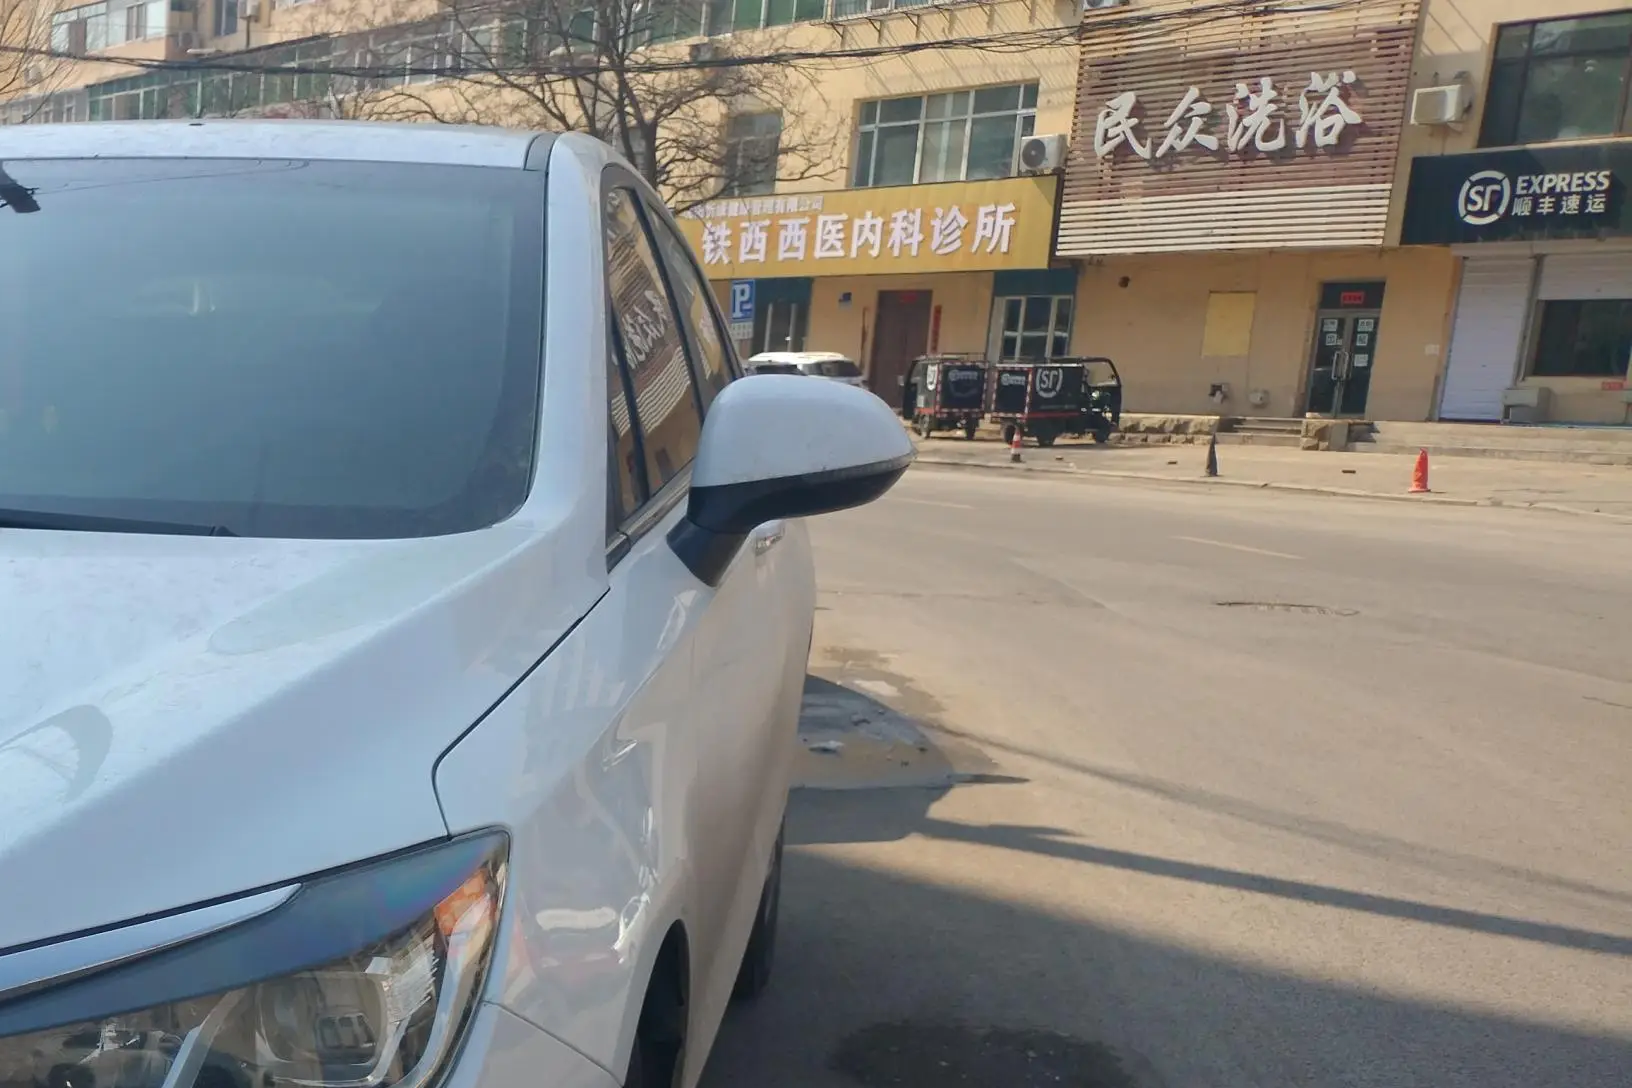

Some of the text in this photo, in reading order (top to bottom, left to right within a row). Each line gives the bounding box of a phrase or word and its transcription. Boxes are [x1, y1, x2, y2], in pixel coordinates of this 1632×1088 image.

[1094, 70, 1362, 159] 民众洗浴
[1515, 170, 1612, 195] EXPRESS
[1511, 193, 1607, 216] 顺丰速运
[701, 201, 1017, 265] 铁西西医内科诊所
[732, 284, 750, 318] P
